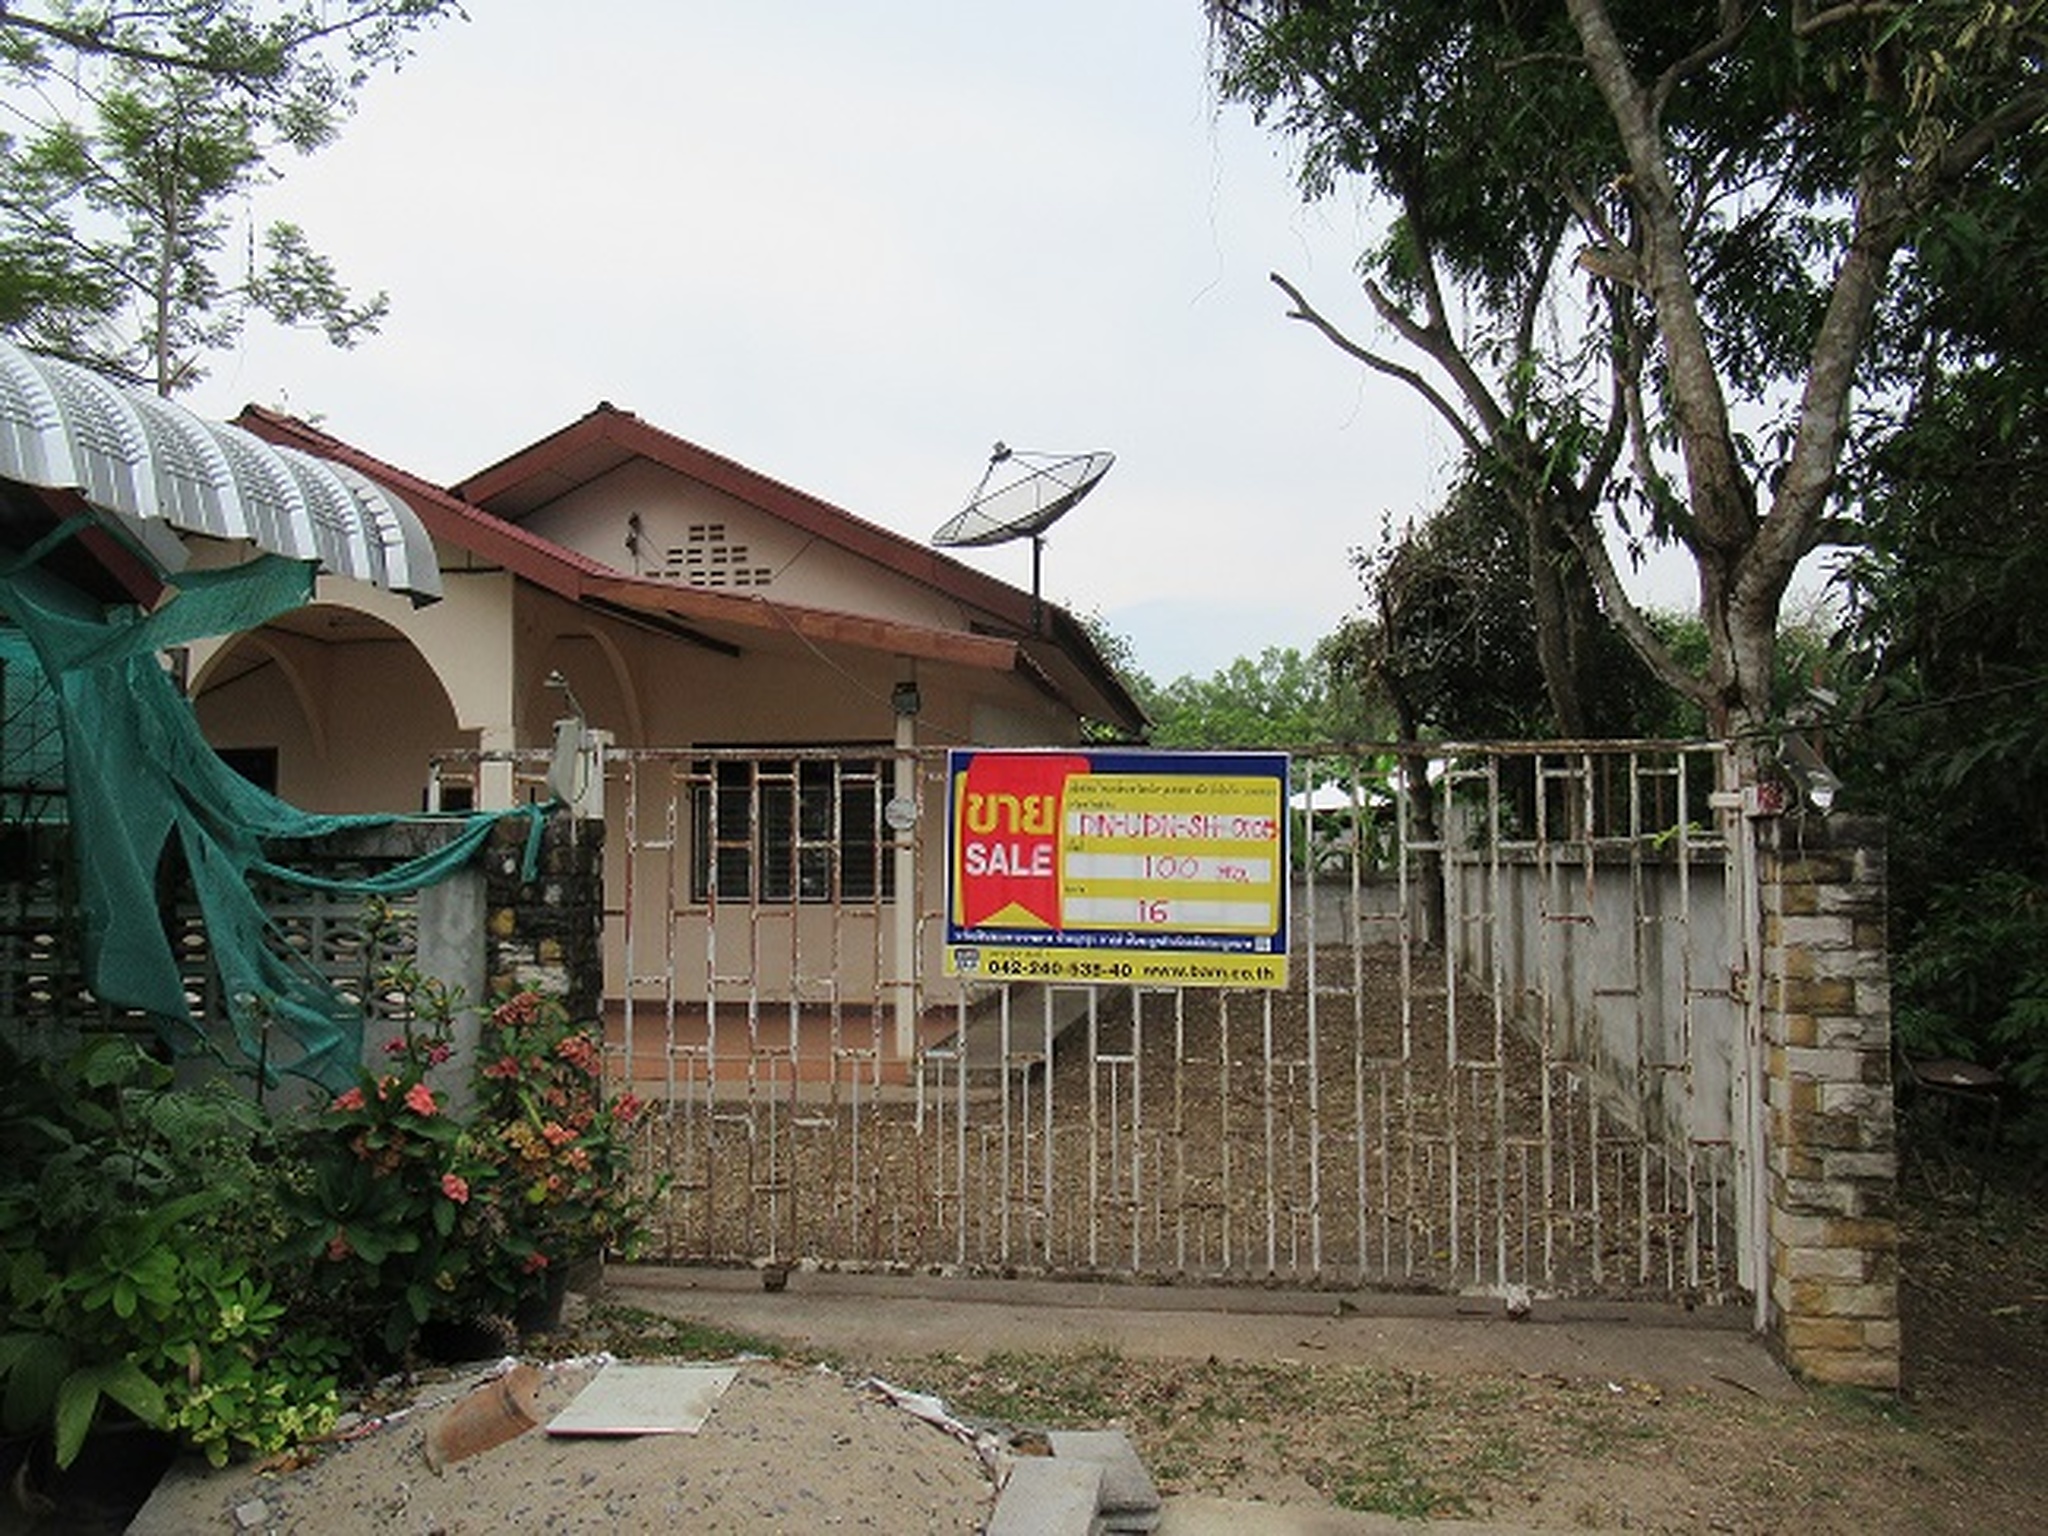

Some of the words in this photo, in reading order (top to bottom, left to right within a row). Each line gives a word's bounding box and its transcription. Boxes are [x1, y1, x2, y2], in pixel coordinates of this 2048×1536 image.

[966, 794, 1054, 835] ขาย
[965, 843, 1052, 877] SALE
[1144, 856, 1199, 879] 100
